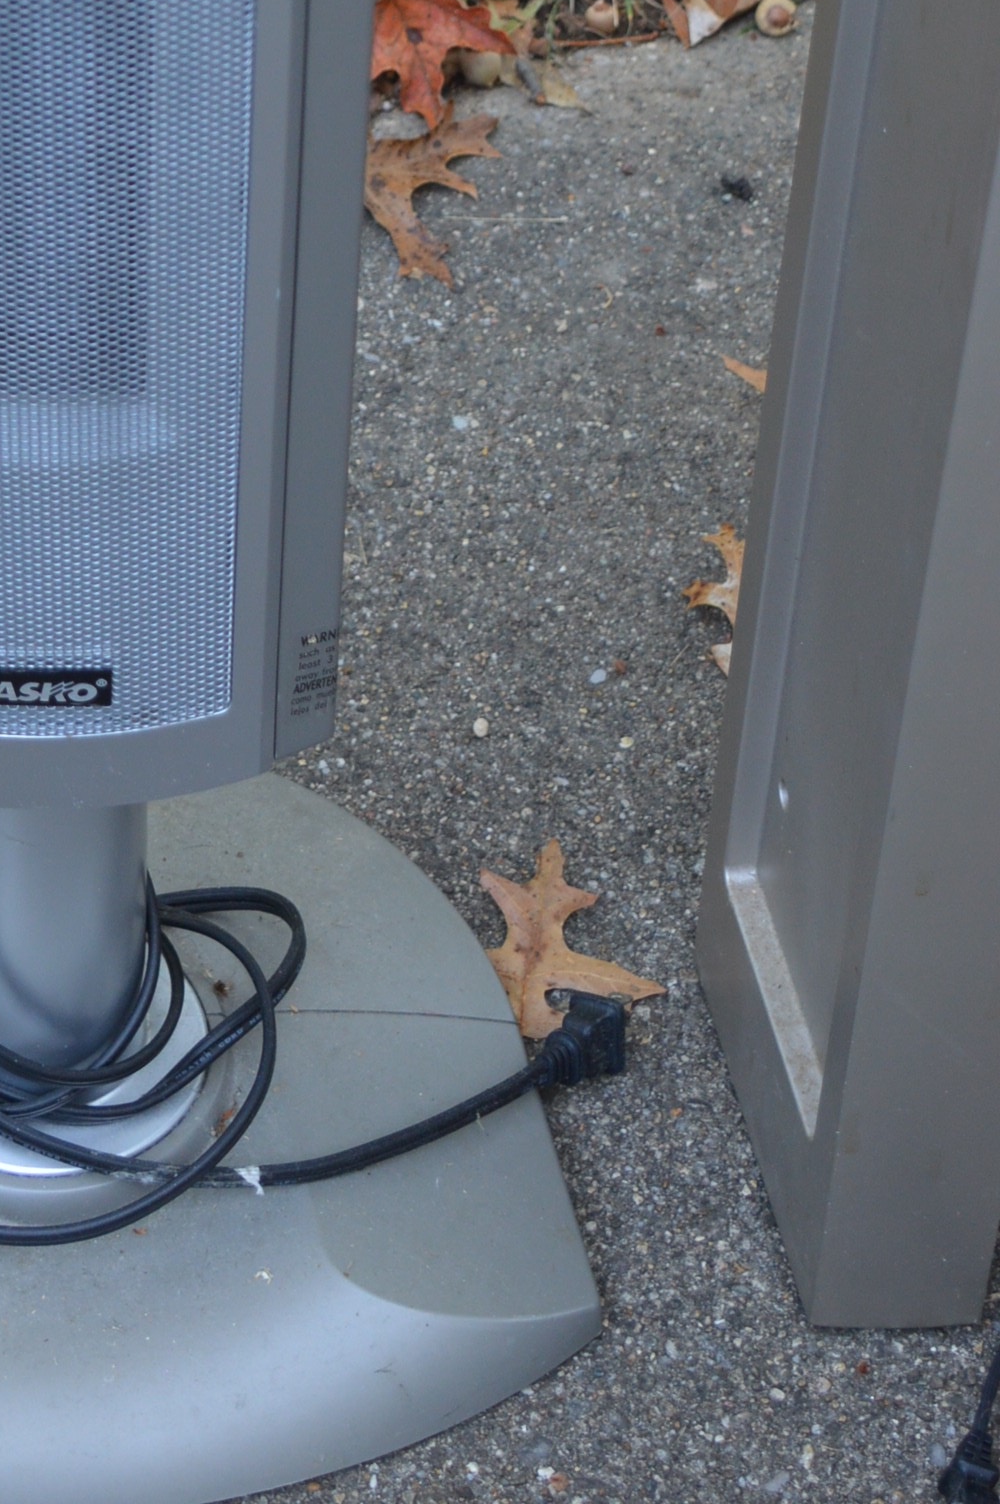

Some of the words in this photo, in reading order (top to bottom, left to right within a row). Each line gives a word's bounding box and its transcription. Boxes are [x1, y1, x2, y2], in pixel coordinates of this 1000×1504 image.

[298, 658, 321, 670] least
[327, 654, 333, 664] 3
[294, 671, 318, 682] away
[290, 695, 312, 705] como
[290, 706, 309, 716] lejos
[314, 699, 328, 710] del
[218, 1028, 244, 1048] CORD
